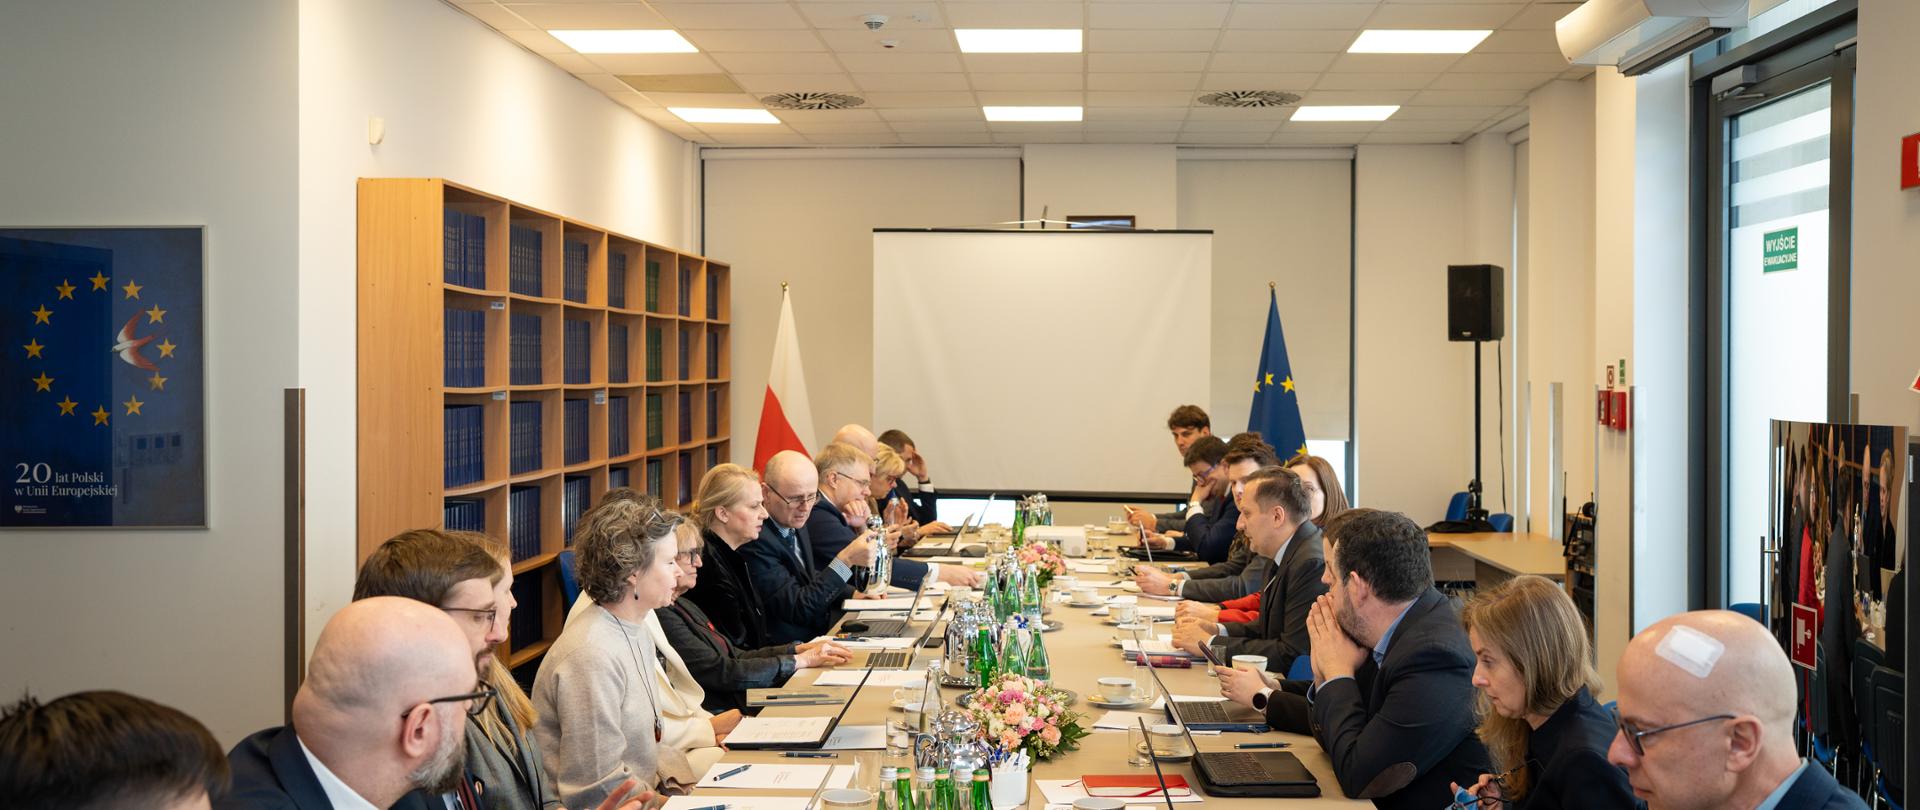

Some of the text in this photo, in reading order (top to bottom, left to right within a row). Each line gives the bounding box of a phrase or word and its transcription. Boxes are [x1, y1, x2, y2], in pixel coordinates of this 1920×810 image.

[1766, 234, 1796, 252] WYJŚCIE
[15, 462, 104, 484] 20 lat Polski
[14, 484, 118, 498] w Unii Europejskiej
